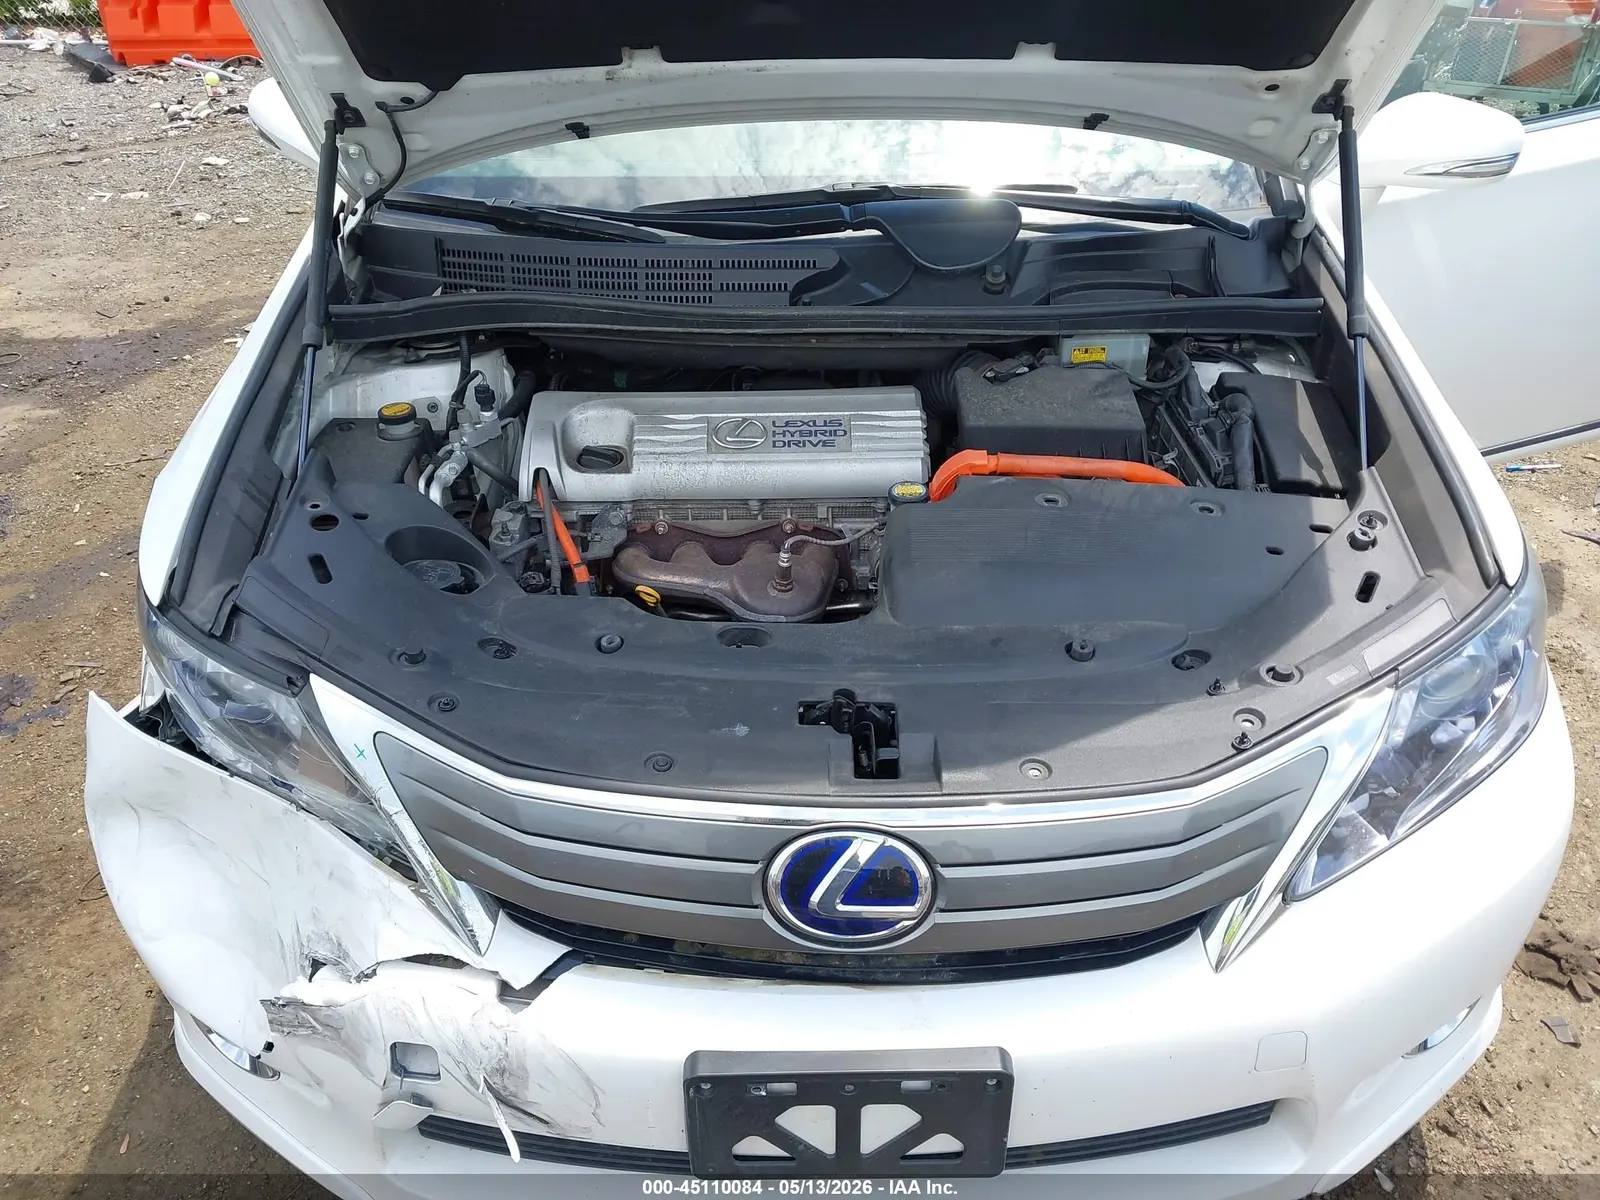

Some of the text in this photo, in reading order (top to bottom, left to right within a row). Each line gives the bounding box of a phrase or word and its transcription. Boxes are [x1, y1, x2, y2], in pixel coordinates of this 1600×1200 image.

[772, 419, 843, 428] LEXUS
[772, 429, 848, 438] HYBRID
[772, 439, 836, 448] DRIVE
